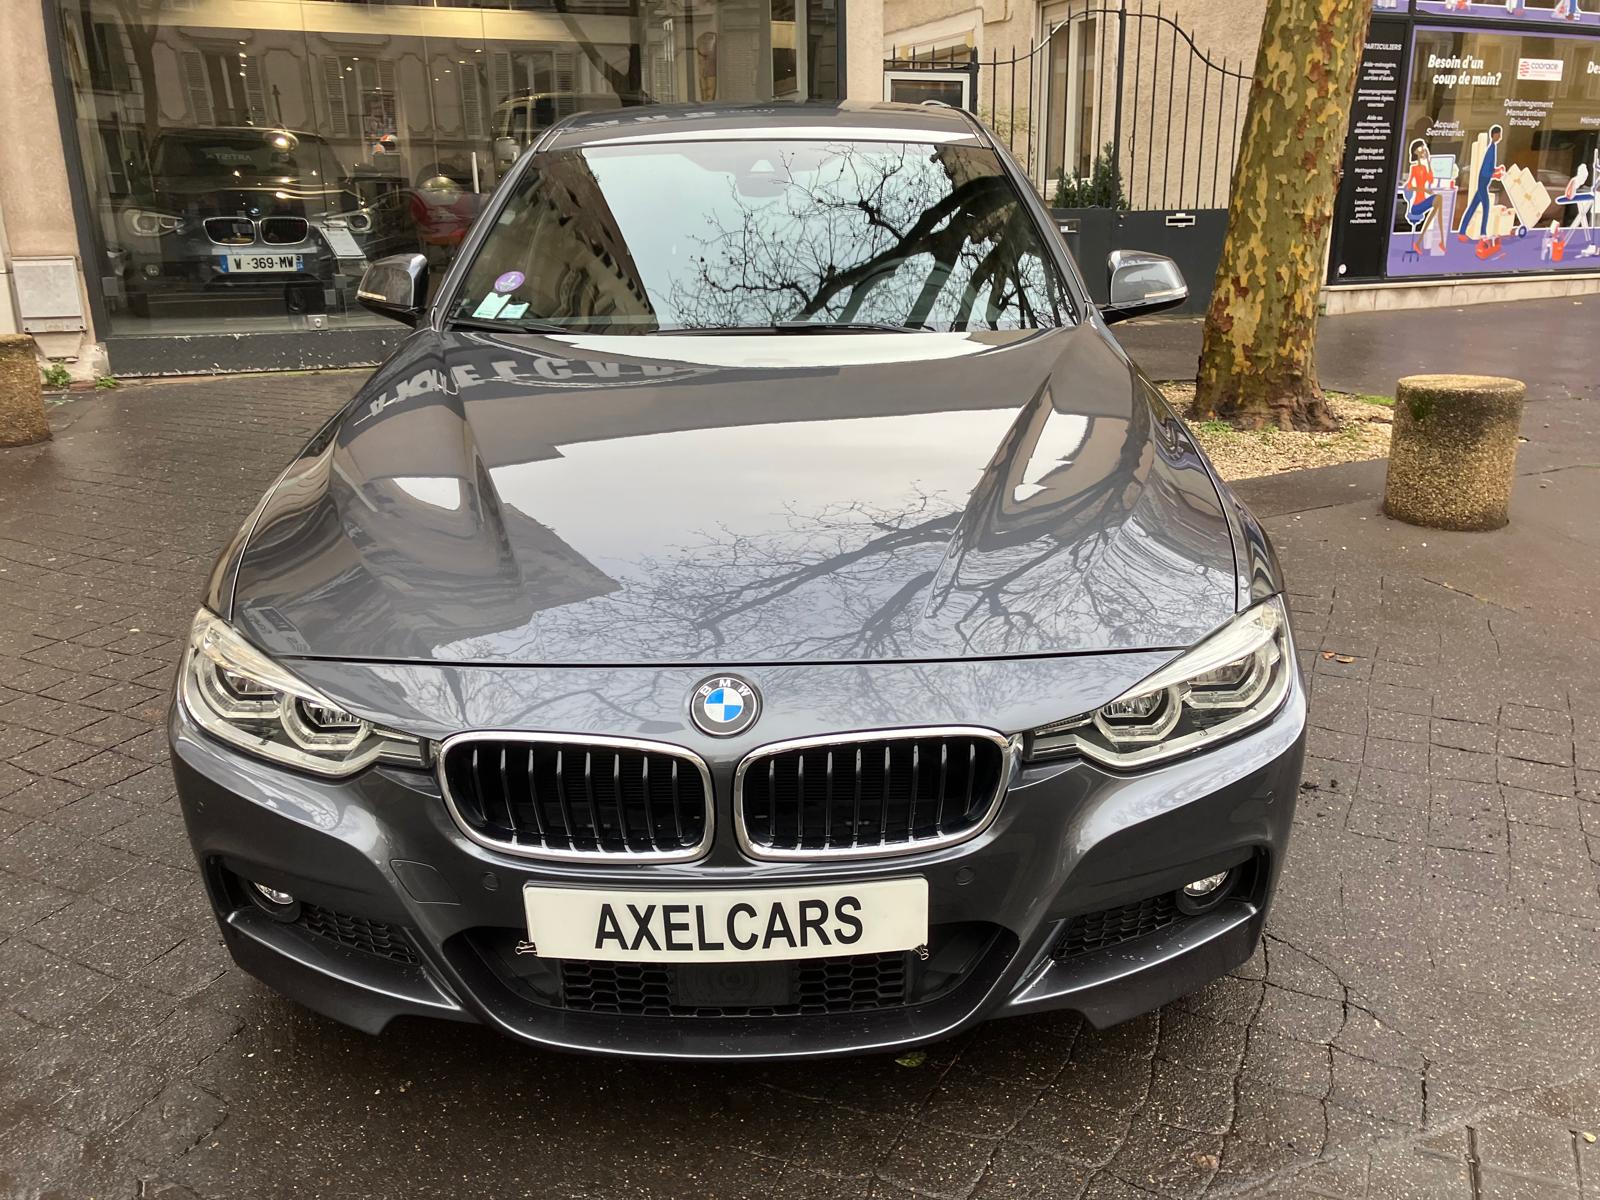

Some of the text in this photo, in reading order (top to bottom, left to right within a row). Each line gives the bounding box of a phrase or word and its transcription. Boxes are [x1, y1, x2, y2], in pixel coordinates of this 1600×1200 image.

[1428, 54, 1484, 69] Besoin d'un
[1432, 71, 1502, 89] coup de main?
[1503, 98, 1554, 110] Déménagement
[1505, 108, 1547, 117] Manutention
[1433, 120, 1460, 128] Accueil
[1509, 117, 1540, 128] Bricolage
[1425, 127, 1465, 137] Secrétariat
[700, 679, 750, 697] BMW
[594, 895, 863, 952] AXELCARS
